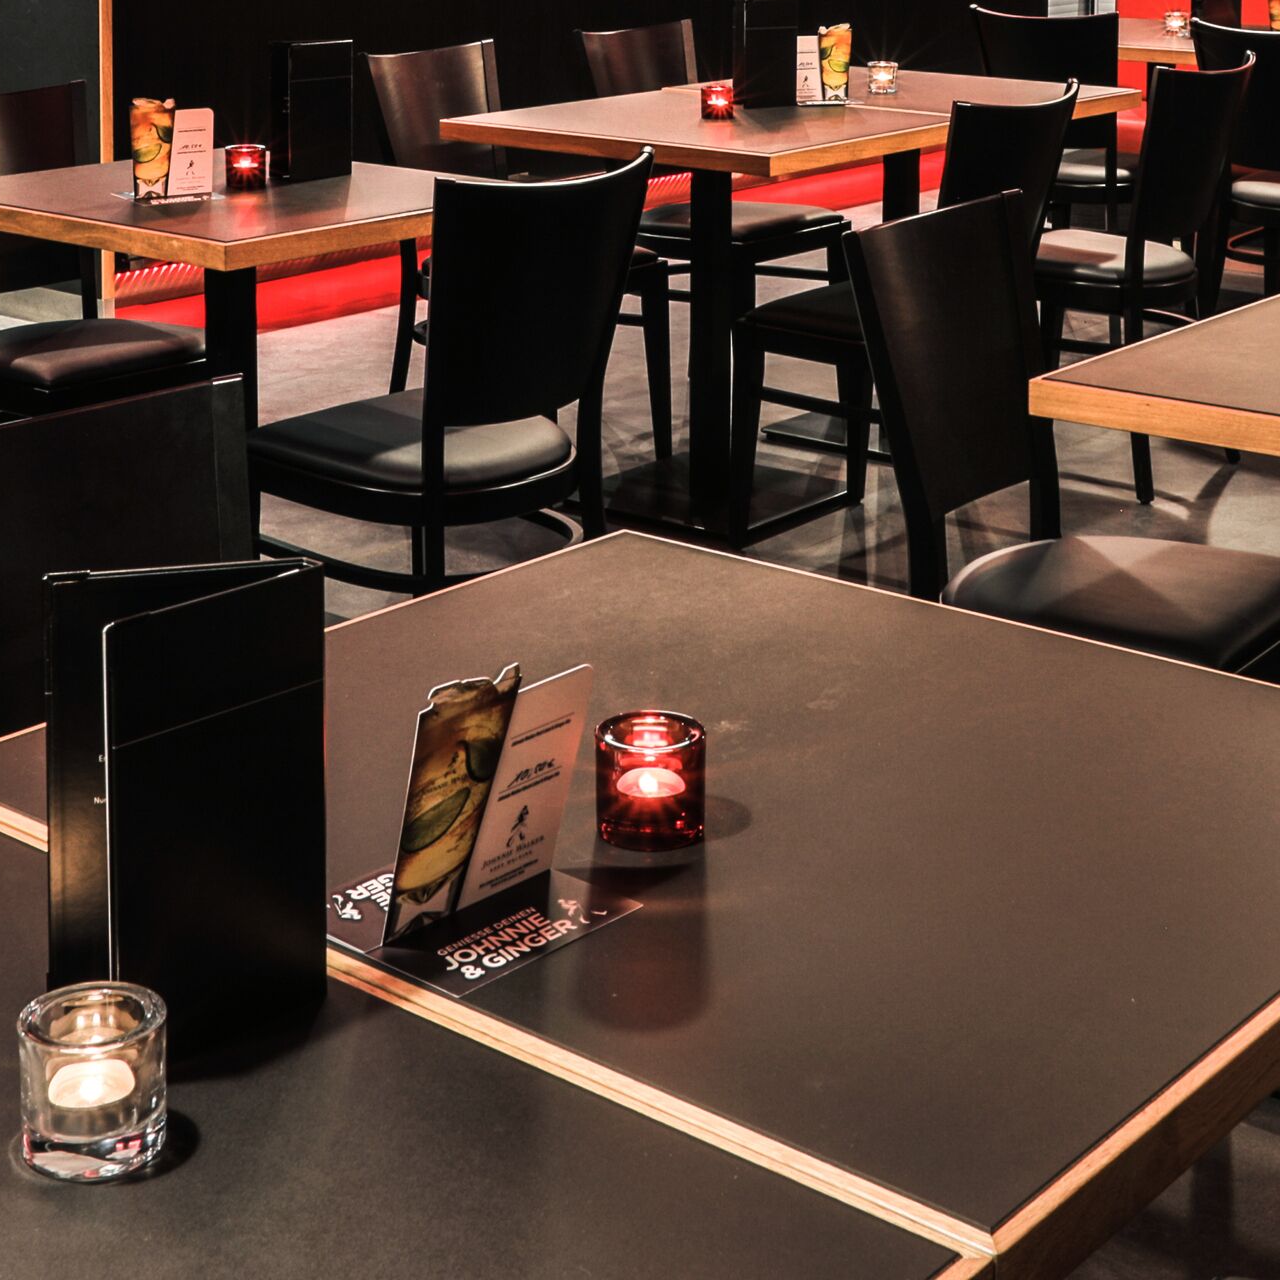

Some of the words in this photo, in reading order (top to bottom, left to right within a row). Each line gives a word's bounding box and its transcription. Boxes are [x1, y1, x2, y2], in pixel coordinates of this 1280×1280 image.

[437, 926, 494, 956] GENIESSE
[493, 906, 537, 930] DEINEN
[444, 912, 551, 971] JOHNNIE
[460, 964, 486, 980] &
[481, 918, 578, 968] GINGER
